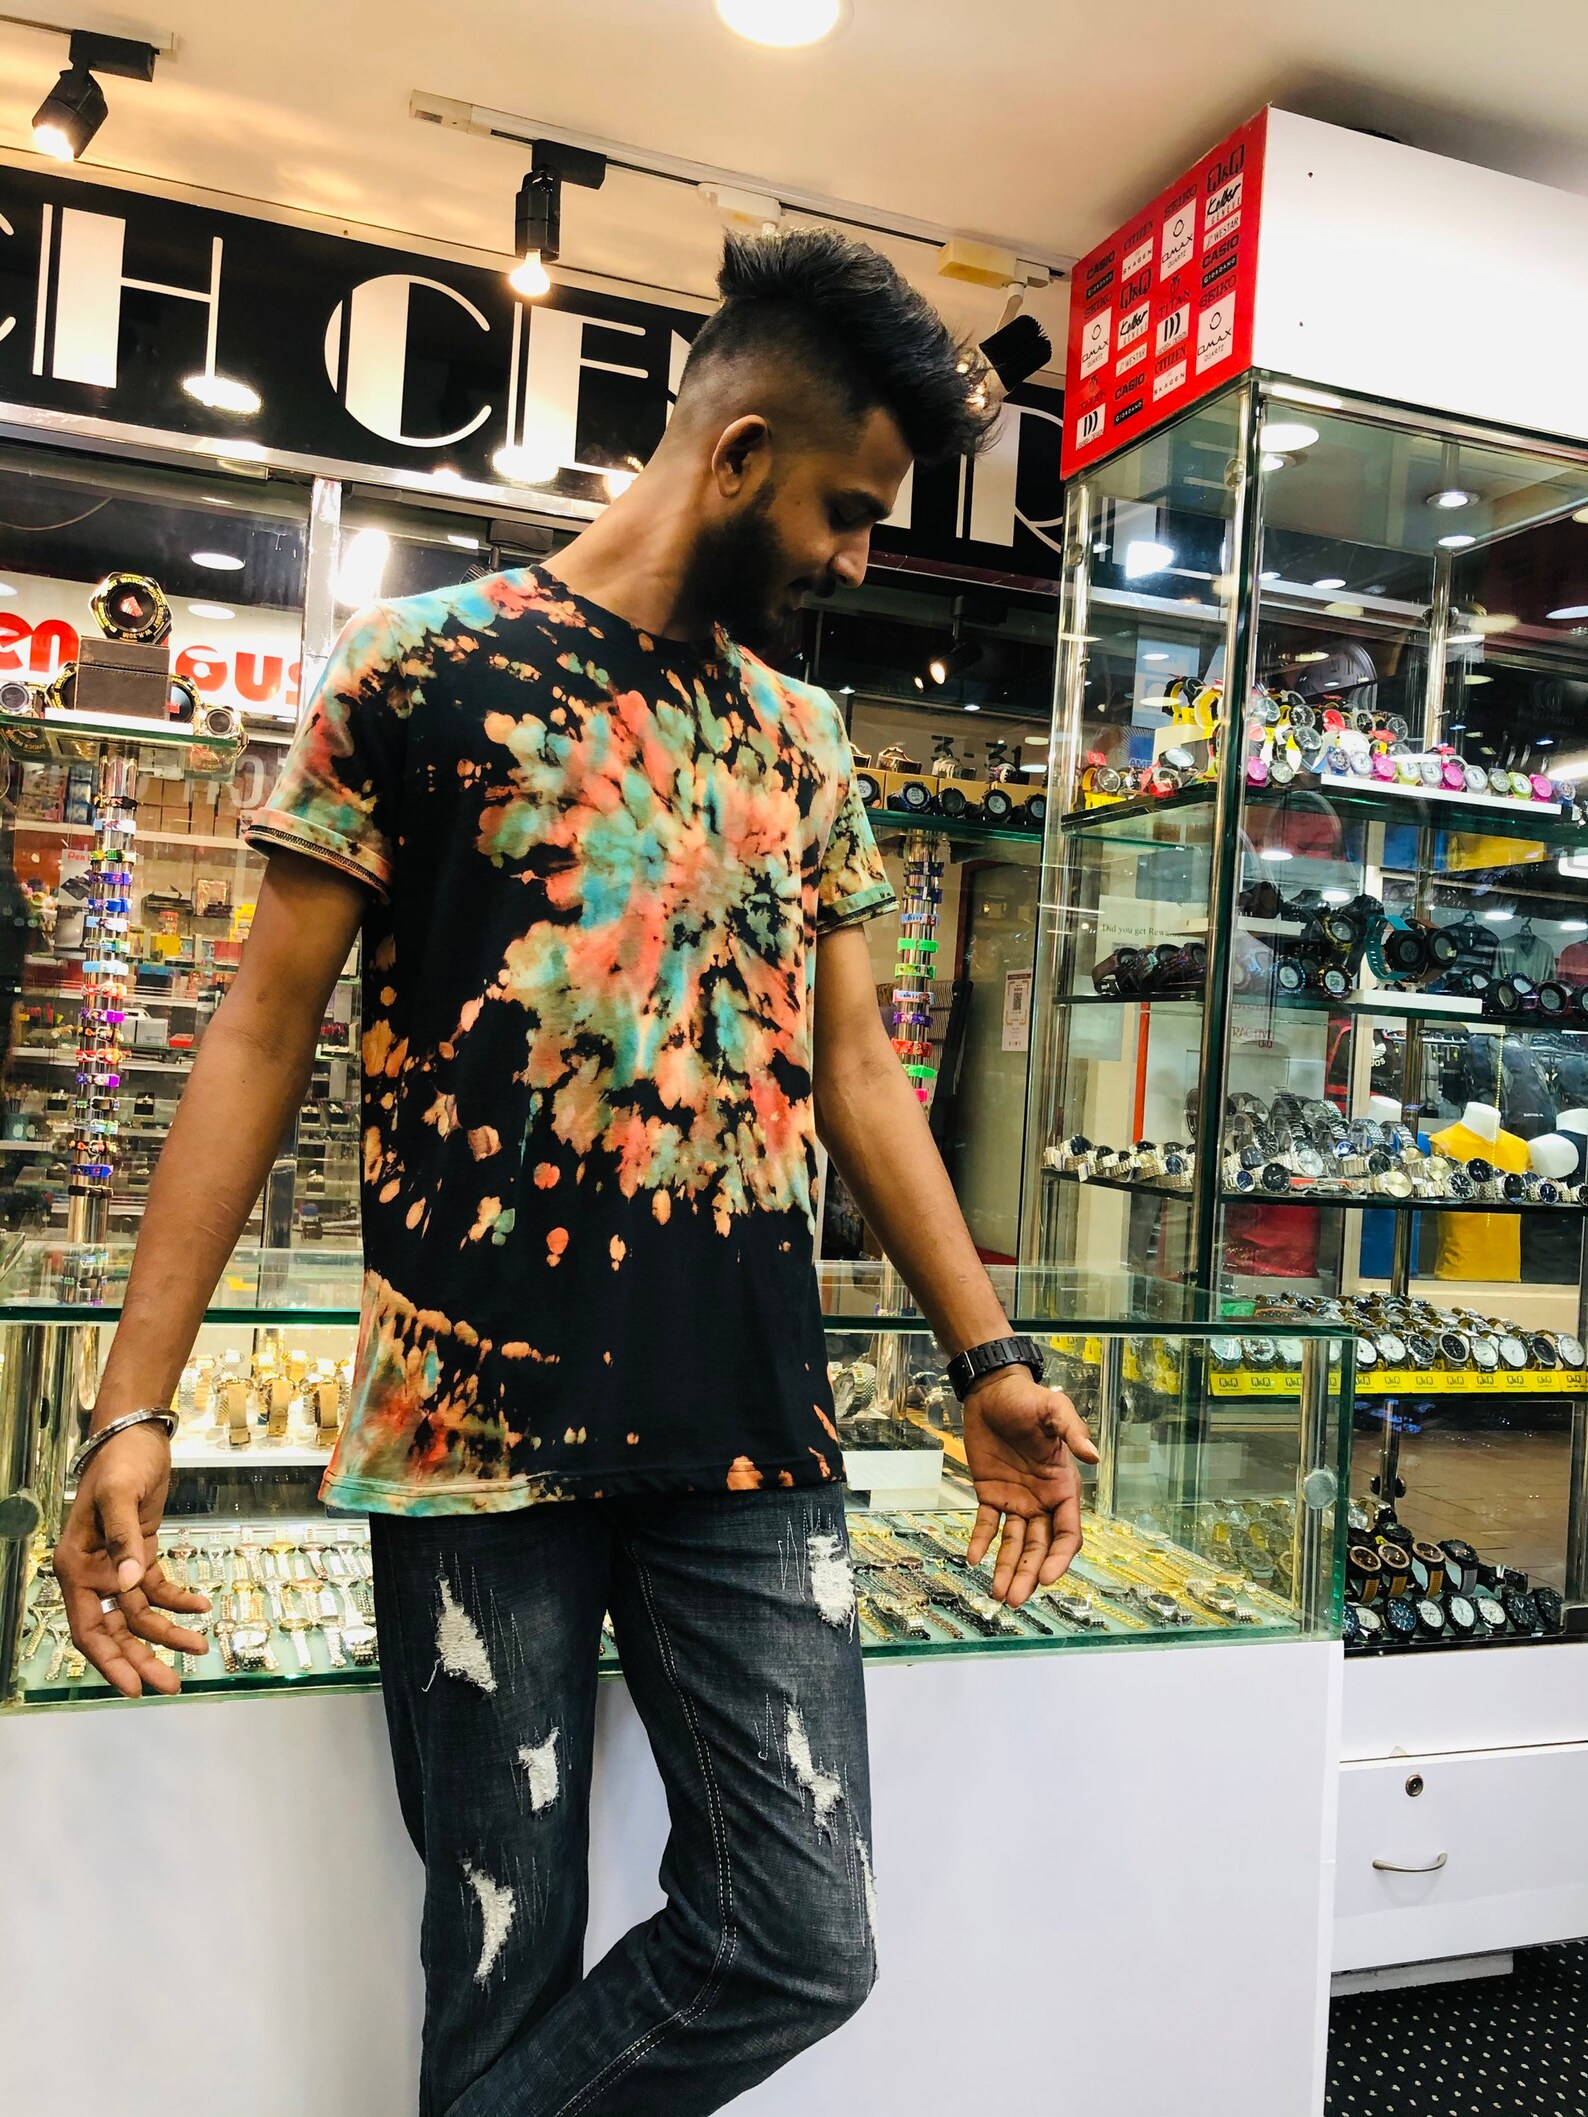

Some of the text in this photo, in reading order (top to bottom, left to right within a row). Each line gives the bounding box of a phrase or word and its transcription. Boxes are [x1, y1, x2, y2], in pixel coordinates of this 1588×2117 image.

[1207, 144, 1245, 194] Q&Q
[1164, 184, 1198, 219] SEIKO
[1212, 197, 1240, 225] GENEVE
[1124, 221, 1153, 252] CITIZEN
[1213, 217, 1239, 242] WESTAR
[1123, 249, 1152, 275] SKAGEN
[1167, 250, 1187, 269] QUARTZ
[1202, 233, 1240, 270] CASIO
[1086, 250, 1116, 280] CASIO
[1204, 257, 1236, 284] GIORDANO
[1087, 273, 1113, 296] GIORDANO
[1120, 268, 1151, 309] Q&Q
[1200, 274, 1237, 309] SEIKO
[1084, 291, 1113, 320] SEIKO
[1159, 290, 1190, 315] TITAN
[1123, 322, 1148, 346] GENEVE
[1155, 345, 1186, 375] CITIZEN
[1203, 344, 1225, 362] QUARTZ
[1115, 372, 1145, 400] CASIO
[1153, 372, 1185, 396] SKAGEN
[1115, 401, 1142, 423] GIORDANO
[1102, 923, 1117, 933] Did
[1118, 926, 1133, 935] you
[1135, 928, 1146, 936] get
[1218, 1377, 1239, 1387] Q&Q
[1251, 1377, 1271, 1387] Q&Q
[1416, 1376, 1434, 1386] Q&Q
[1446, 1376, 1465, 1386] Q&Q
[1476, 1375, 1495, 1385] Q&Q
[1506, 1375, 1524, 1385] Q&Q
[1537, 1375, 1552, 1384] Q&Q
[1566, 1374, 1582, 1384] Q&Q
